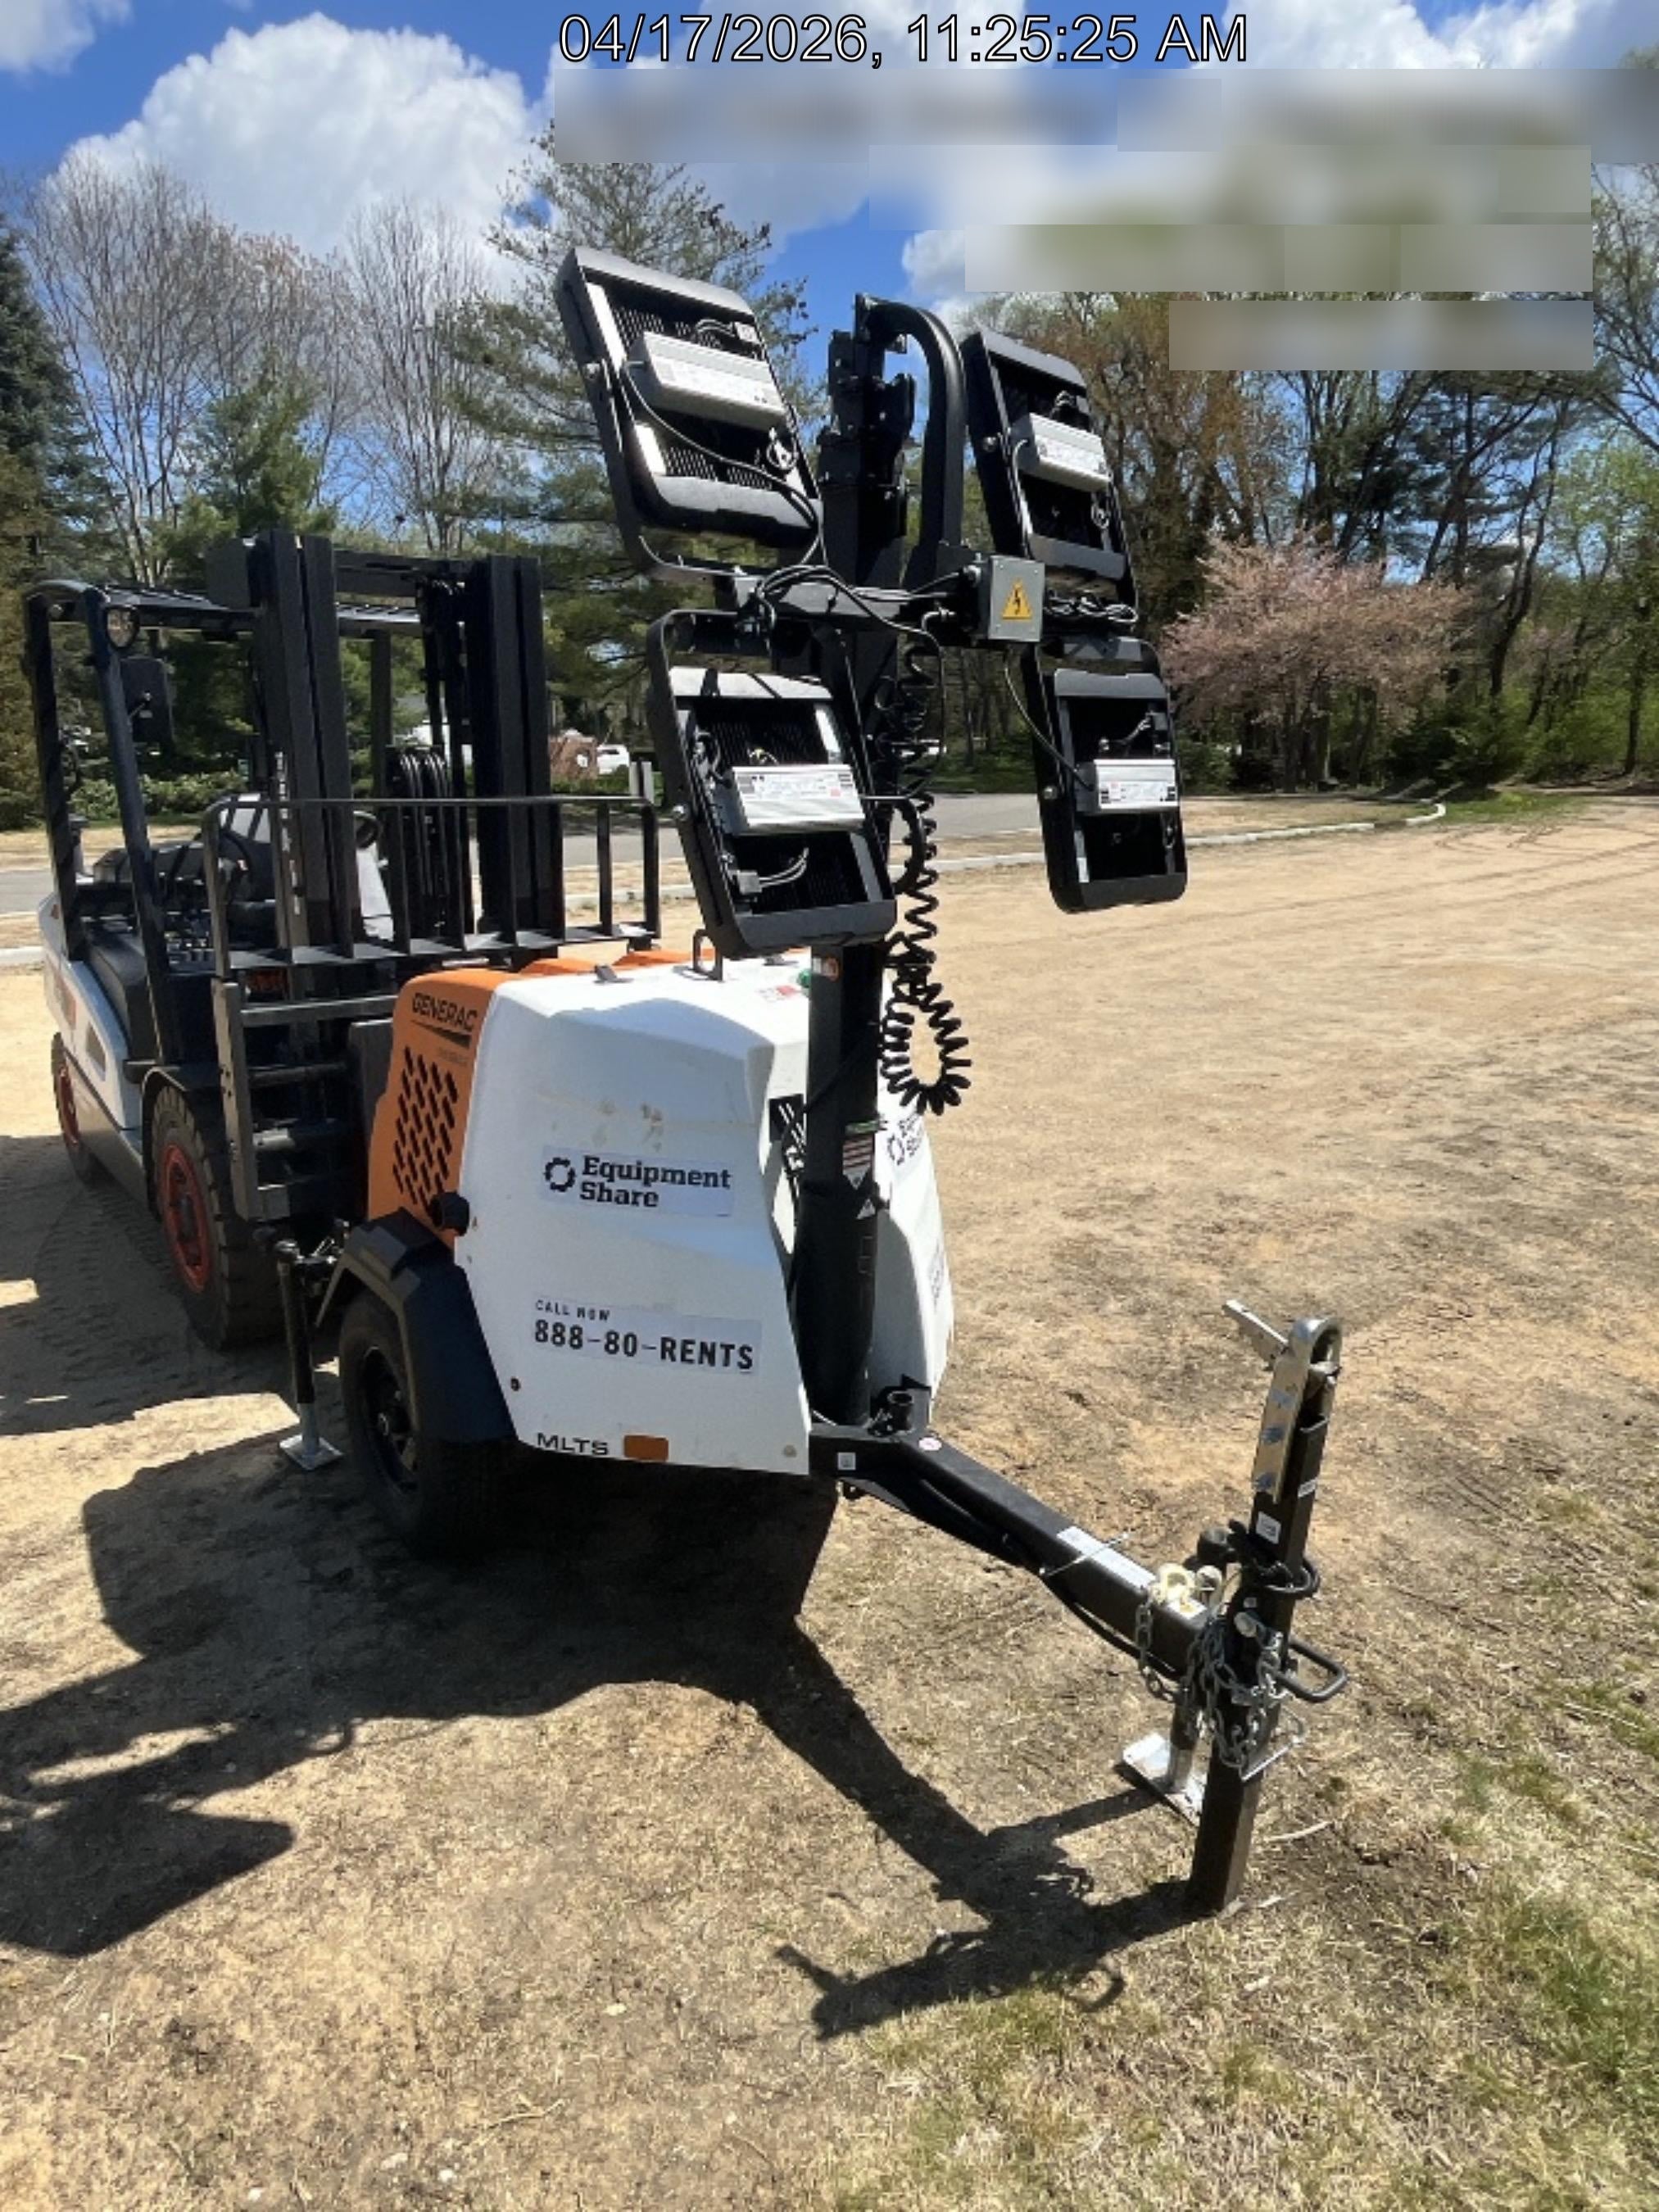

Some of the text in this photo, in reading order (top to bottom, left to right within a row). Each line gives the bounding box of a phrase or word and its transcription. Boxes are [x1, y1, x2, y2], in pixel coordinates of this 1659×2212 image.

[412, 991, 478, 1032] GENERAC
[582, 1155, 732, 1189] Equipment
[579, 1181, 660, 1208] Share
[535, 1299, 610, 1321] CALL NOW
[534, 1319, 753, 1371] 888-80-RENTS
[537, 1432, 609, 1456] MLTS
